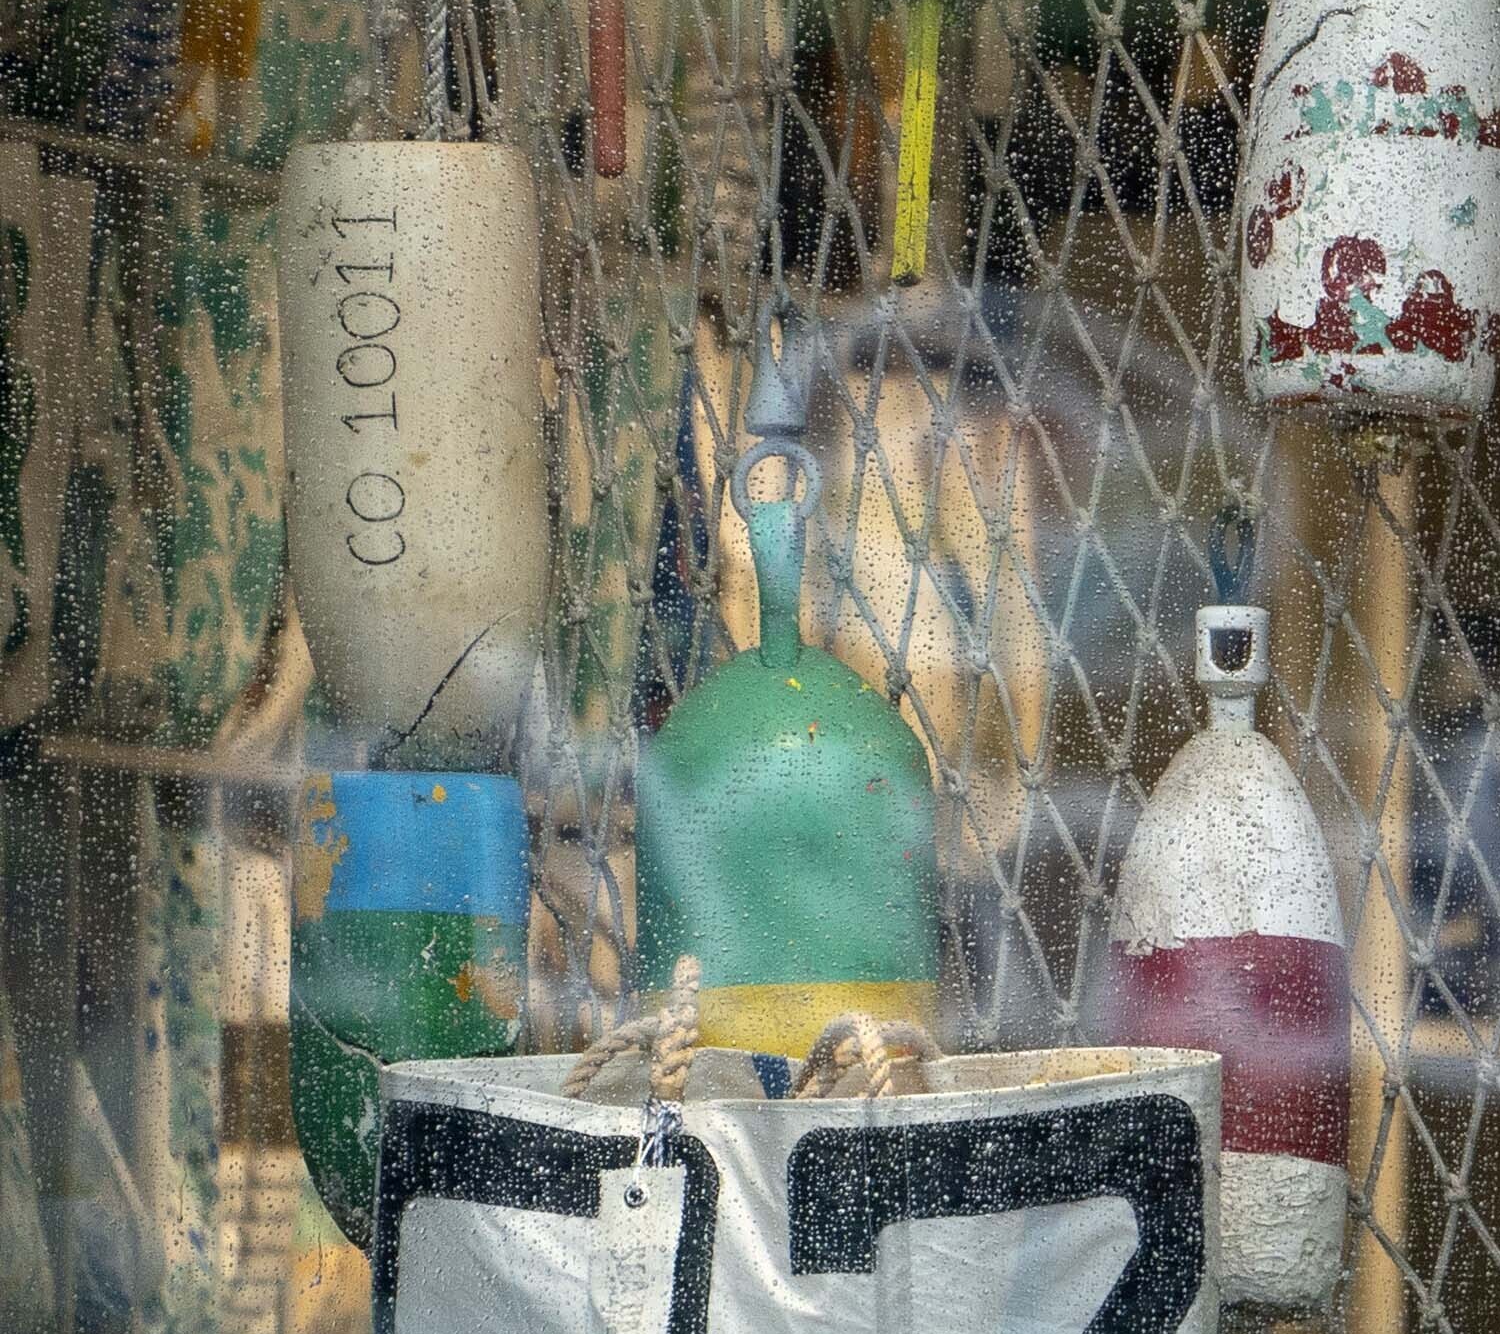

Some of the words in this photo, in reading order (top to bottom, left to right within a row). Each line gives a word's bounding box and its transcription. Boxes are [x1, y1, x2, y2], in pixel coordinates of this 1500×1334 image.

[331, 205, 401, 434] 10011
[346, 472, 406, 566] CO
[610, 1245, 648, 1293] SEA
